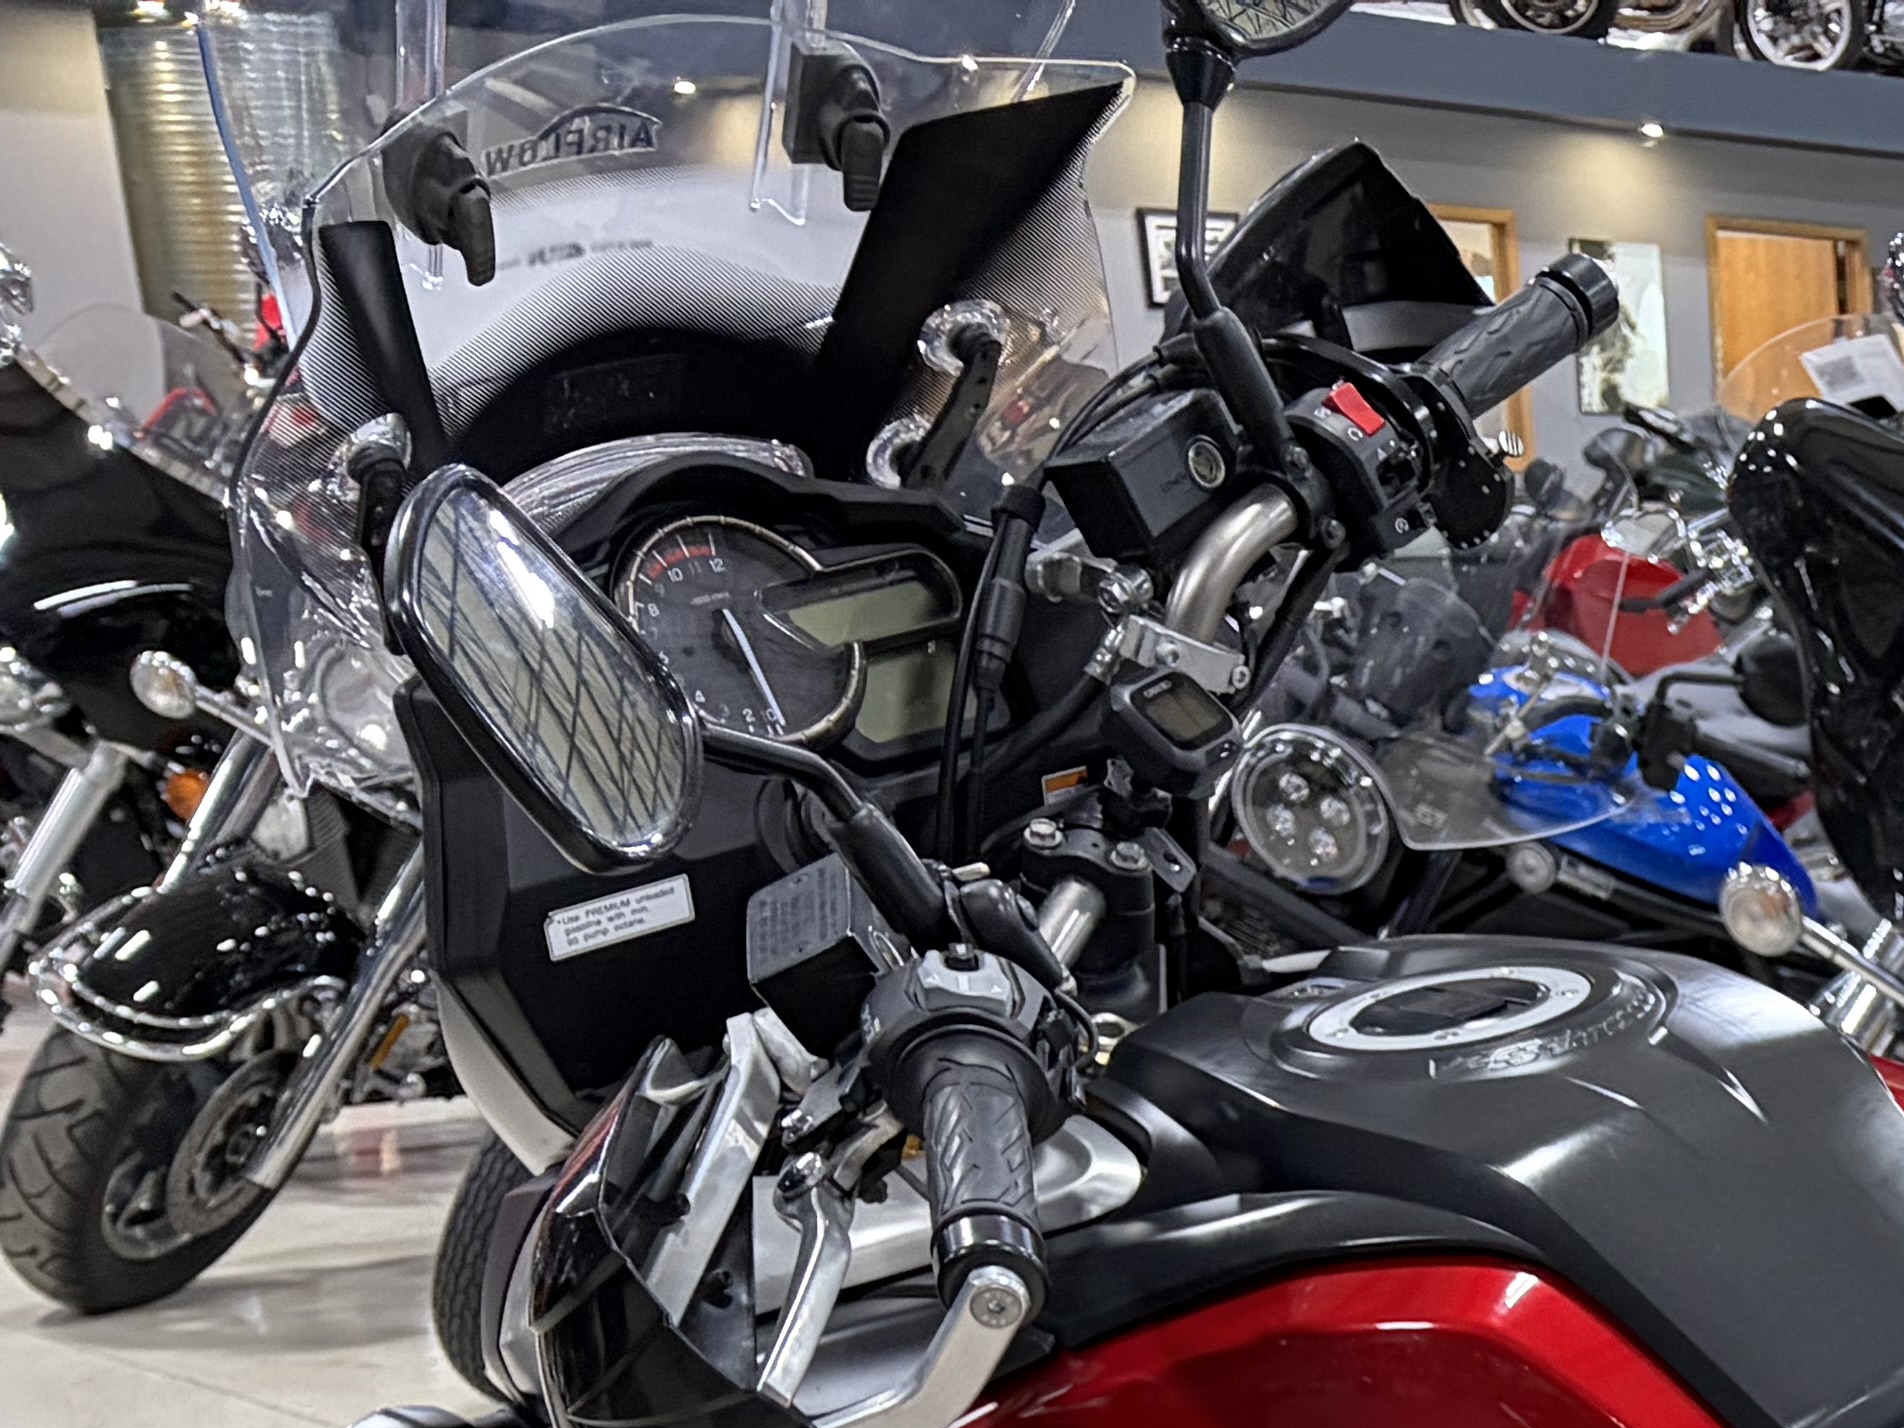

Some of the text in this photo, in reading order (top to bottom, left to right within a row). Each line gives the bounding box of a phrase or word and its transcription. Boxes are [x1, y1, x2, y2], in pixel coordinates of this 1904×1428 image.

[709, 558, 725, 573] 12
[667, 567, 683, 583] 10
[648, 603, 660, 617] 8
[743, 708, 755, 722] 2
[585, 898, 630, 918] PREMIUM
[635, 886, 675, 904] unleaded
[564, 919, 602, 936] gasoline
[607, 911, 626, 923] with
[583, 927, 610, 942] pump
